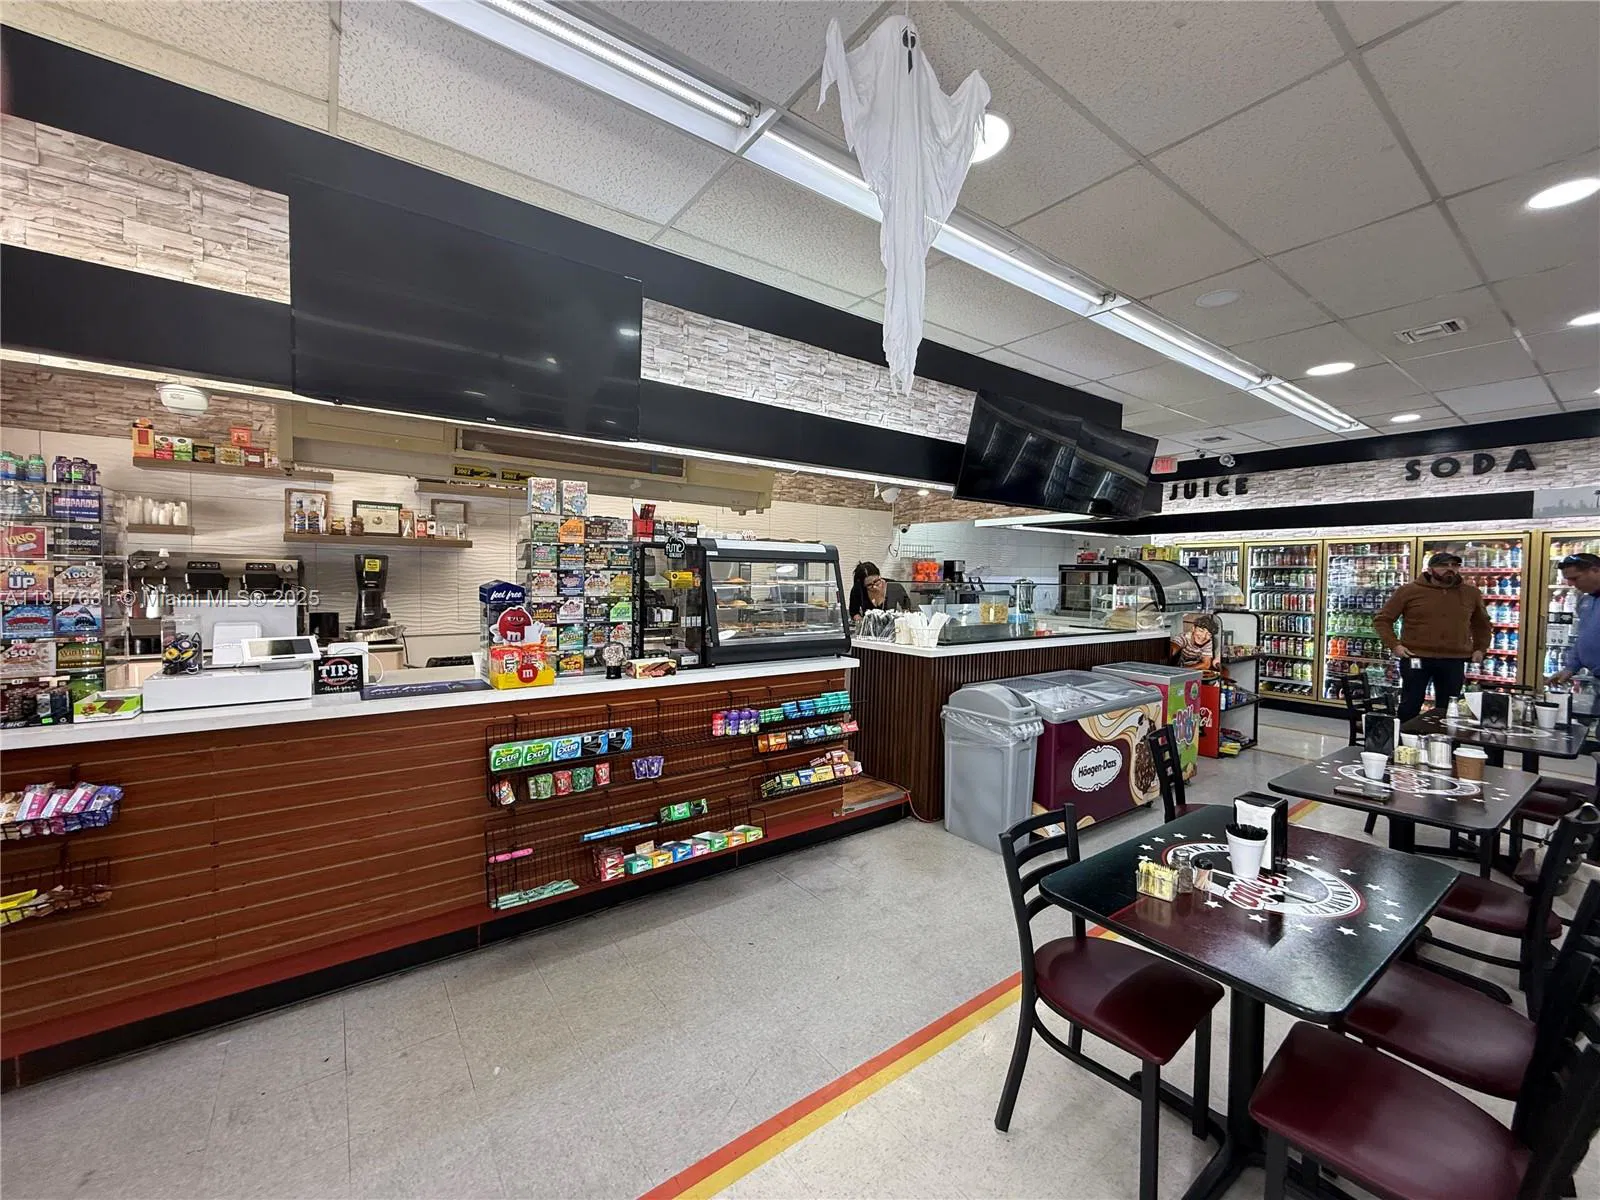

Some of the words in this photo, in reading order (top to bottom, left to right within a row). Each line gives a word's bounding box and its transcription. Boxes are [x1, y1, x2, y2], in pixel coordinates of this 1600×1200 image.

[1405, 449, 1537, 481] SODA
[1168, 477, 1249, 501] JUICE
[9, 577, 35, 589] UP
[490, 590, 505, 600] feel
[505, 590, 522, 600] free
[318, 664, 358, 677] TIPS
[522, 669, 533, 678] m
[527, 747, 550, 761] Extra
[557, 742, 578, 755] Extra
[496, 751, 520, 765] Extra
[1078, 760, 1117, 777] Häagen-Dazs
